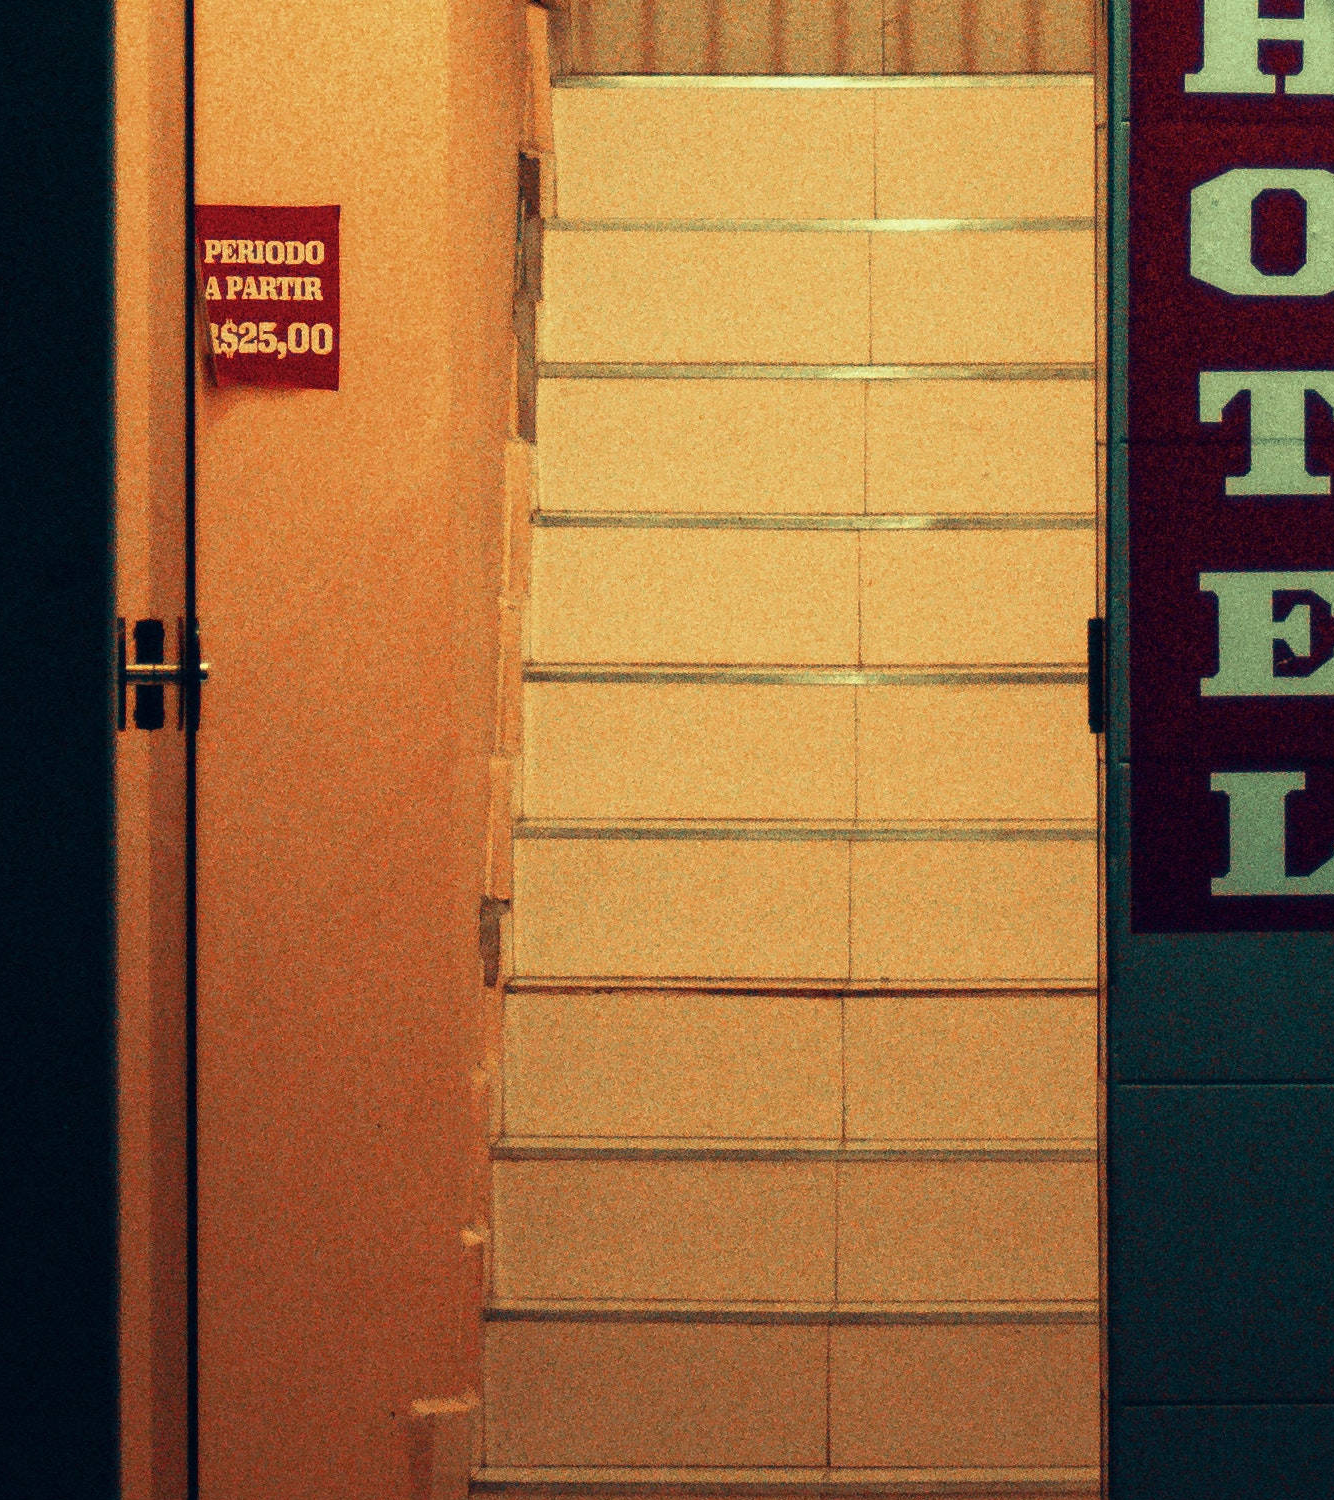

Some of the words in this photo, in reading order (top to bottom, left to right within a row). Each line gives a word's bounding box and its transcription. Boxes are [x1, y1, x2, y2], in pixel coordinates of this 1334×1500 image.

[203, 239, 326, 265] PERIODO
[205, 276, 222, 301] A
[225, 276, 324, 301] PARTIR
